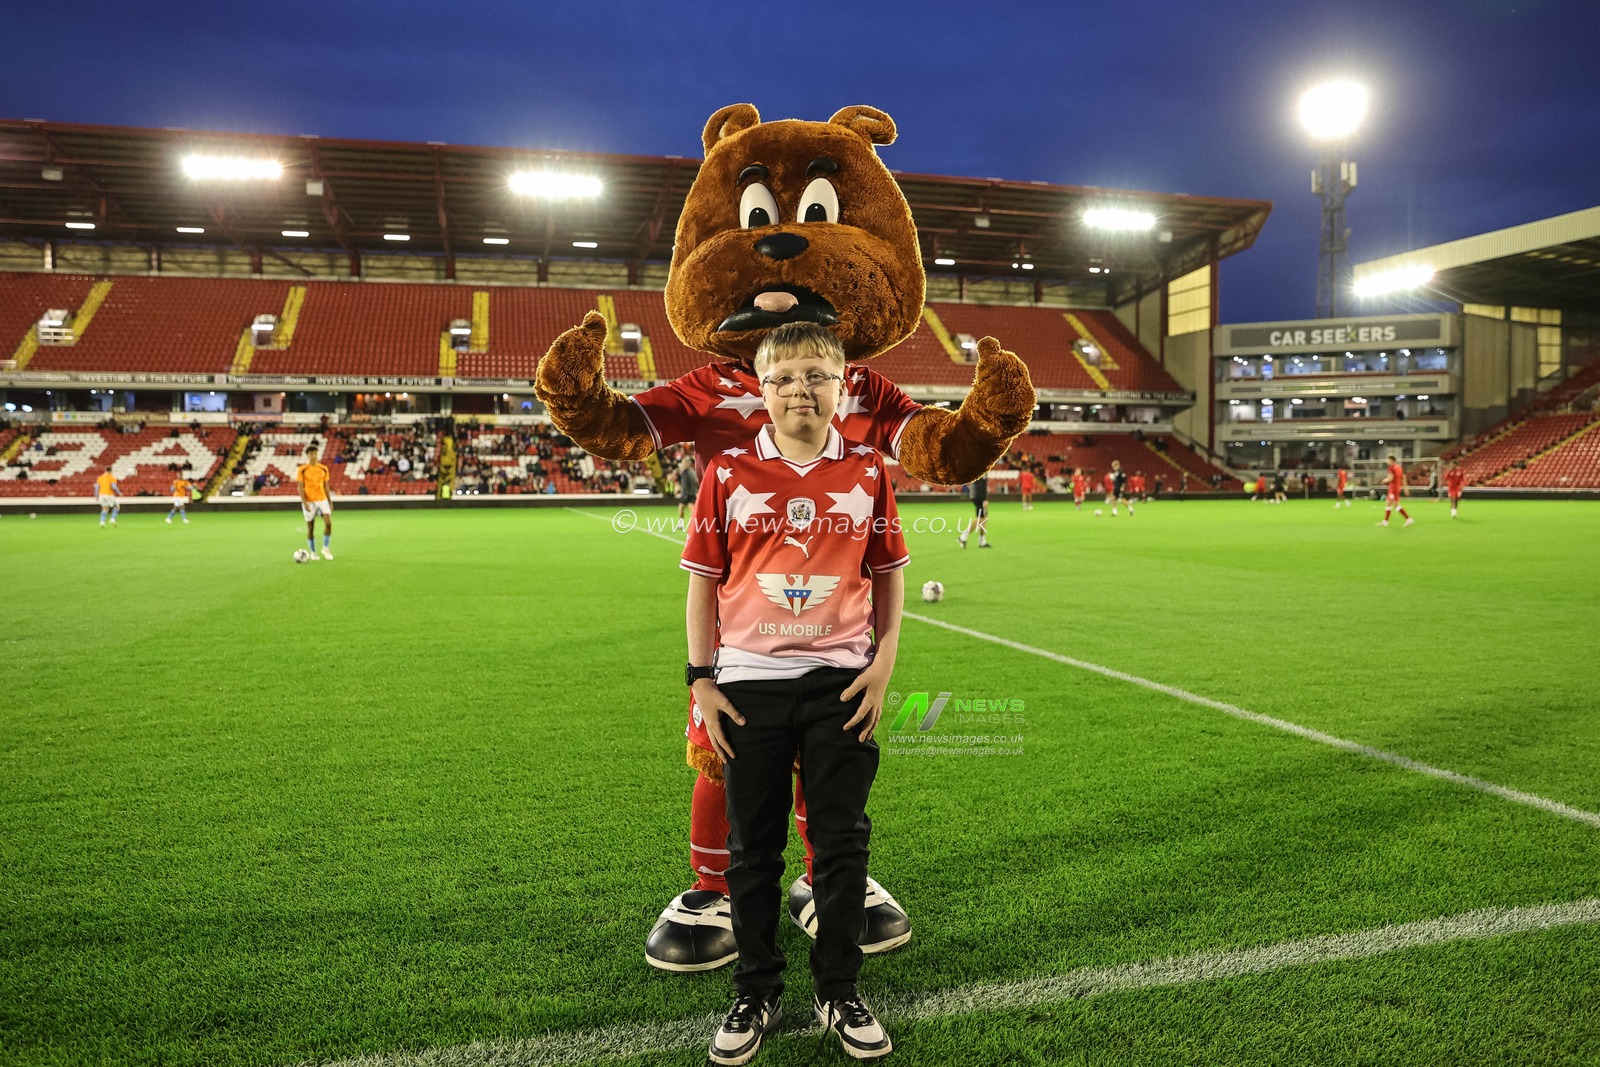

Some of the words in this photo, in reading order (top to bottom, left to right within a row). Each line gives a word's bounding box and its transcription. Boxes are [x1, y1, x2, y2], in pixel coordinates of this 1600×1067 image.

[1270, 330, 1306, 346] CAR
[1310, 325, 1396, 344] SEEKERS
[79, 373, 132, 382] INVESTING
[135, 374, 146, 382] IN
[149, 374, 168, 383] THE
[171, 374, 208, 383] FUTURE
[315, 377, 365, 385] INVESTING
[367, 377, 378, 385] IN
[381, 377, 399, 385] THE
[401, 377, 436, 386] FUTURE
[617, 381, 649, 389] FUTURE
[758, 622, 777, 635] US
[780, 623, 833, 637] MOBILE
